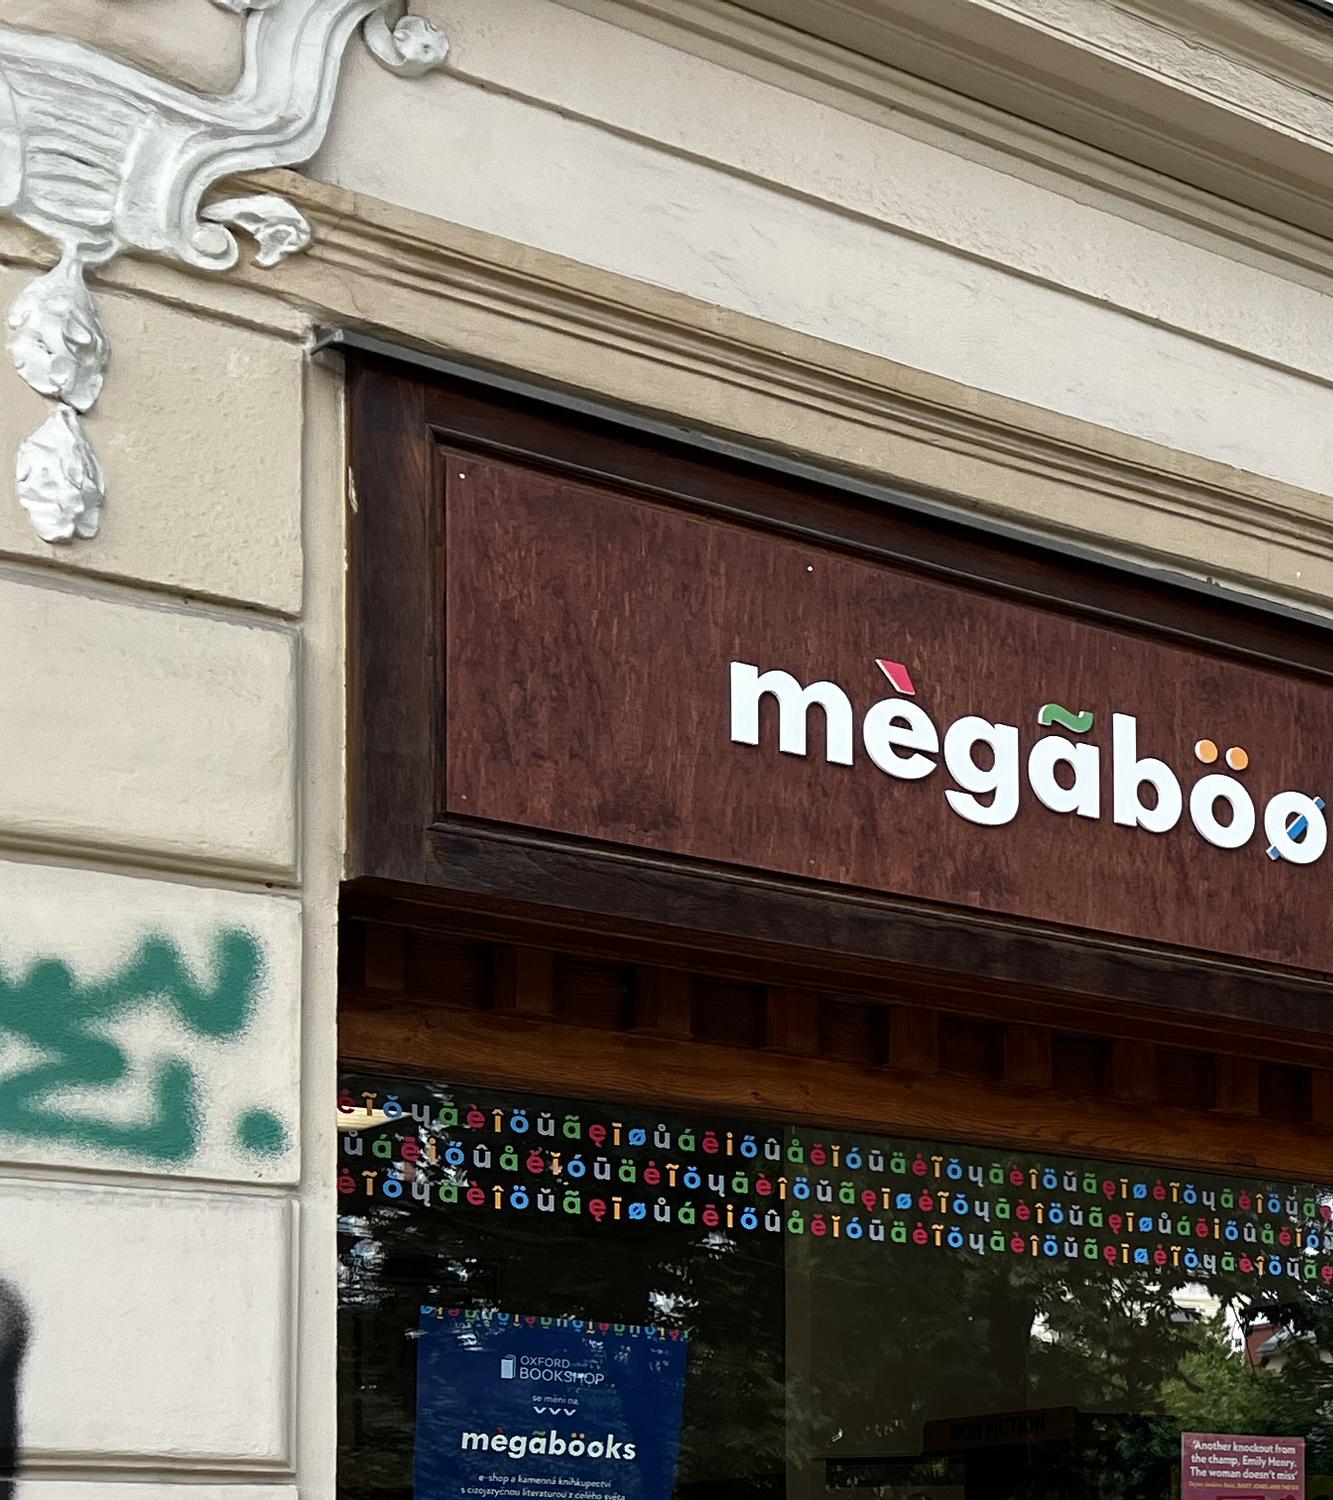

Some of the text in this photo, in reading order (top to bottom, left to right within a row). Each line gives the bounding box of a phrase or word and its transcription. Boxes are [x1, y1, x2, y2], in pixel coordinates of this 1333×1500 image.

[520, 1355, 570, 1369] OXFORD
[519, 1367, 605, 1385] BOOKSHOP
[1233, 1441, 1273, 1453] knockout
[1275, 1443, 1296, 1454] from
[1191, 1454, 1207, 1464] the
[1242, 1455, 1267, 1468] Emily
[1190, 1466, 1207, 1477] The
[1208, 1469, 1241, 1478] woman
